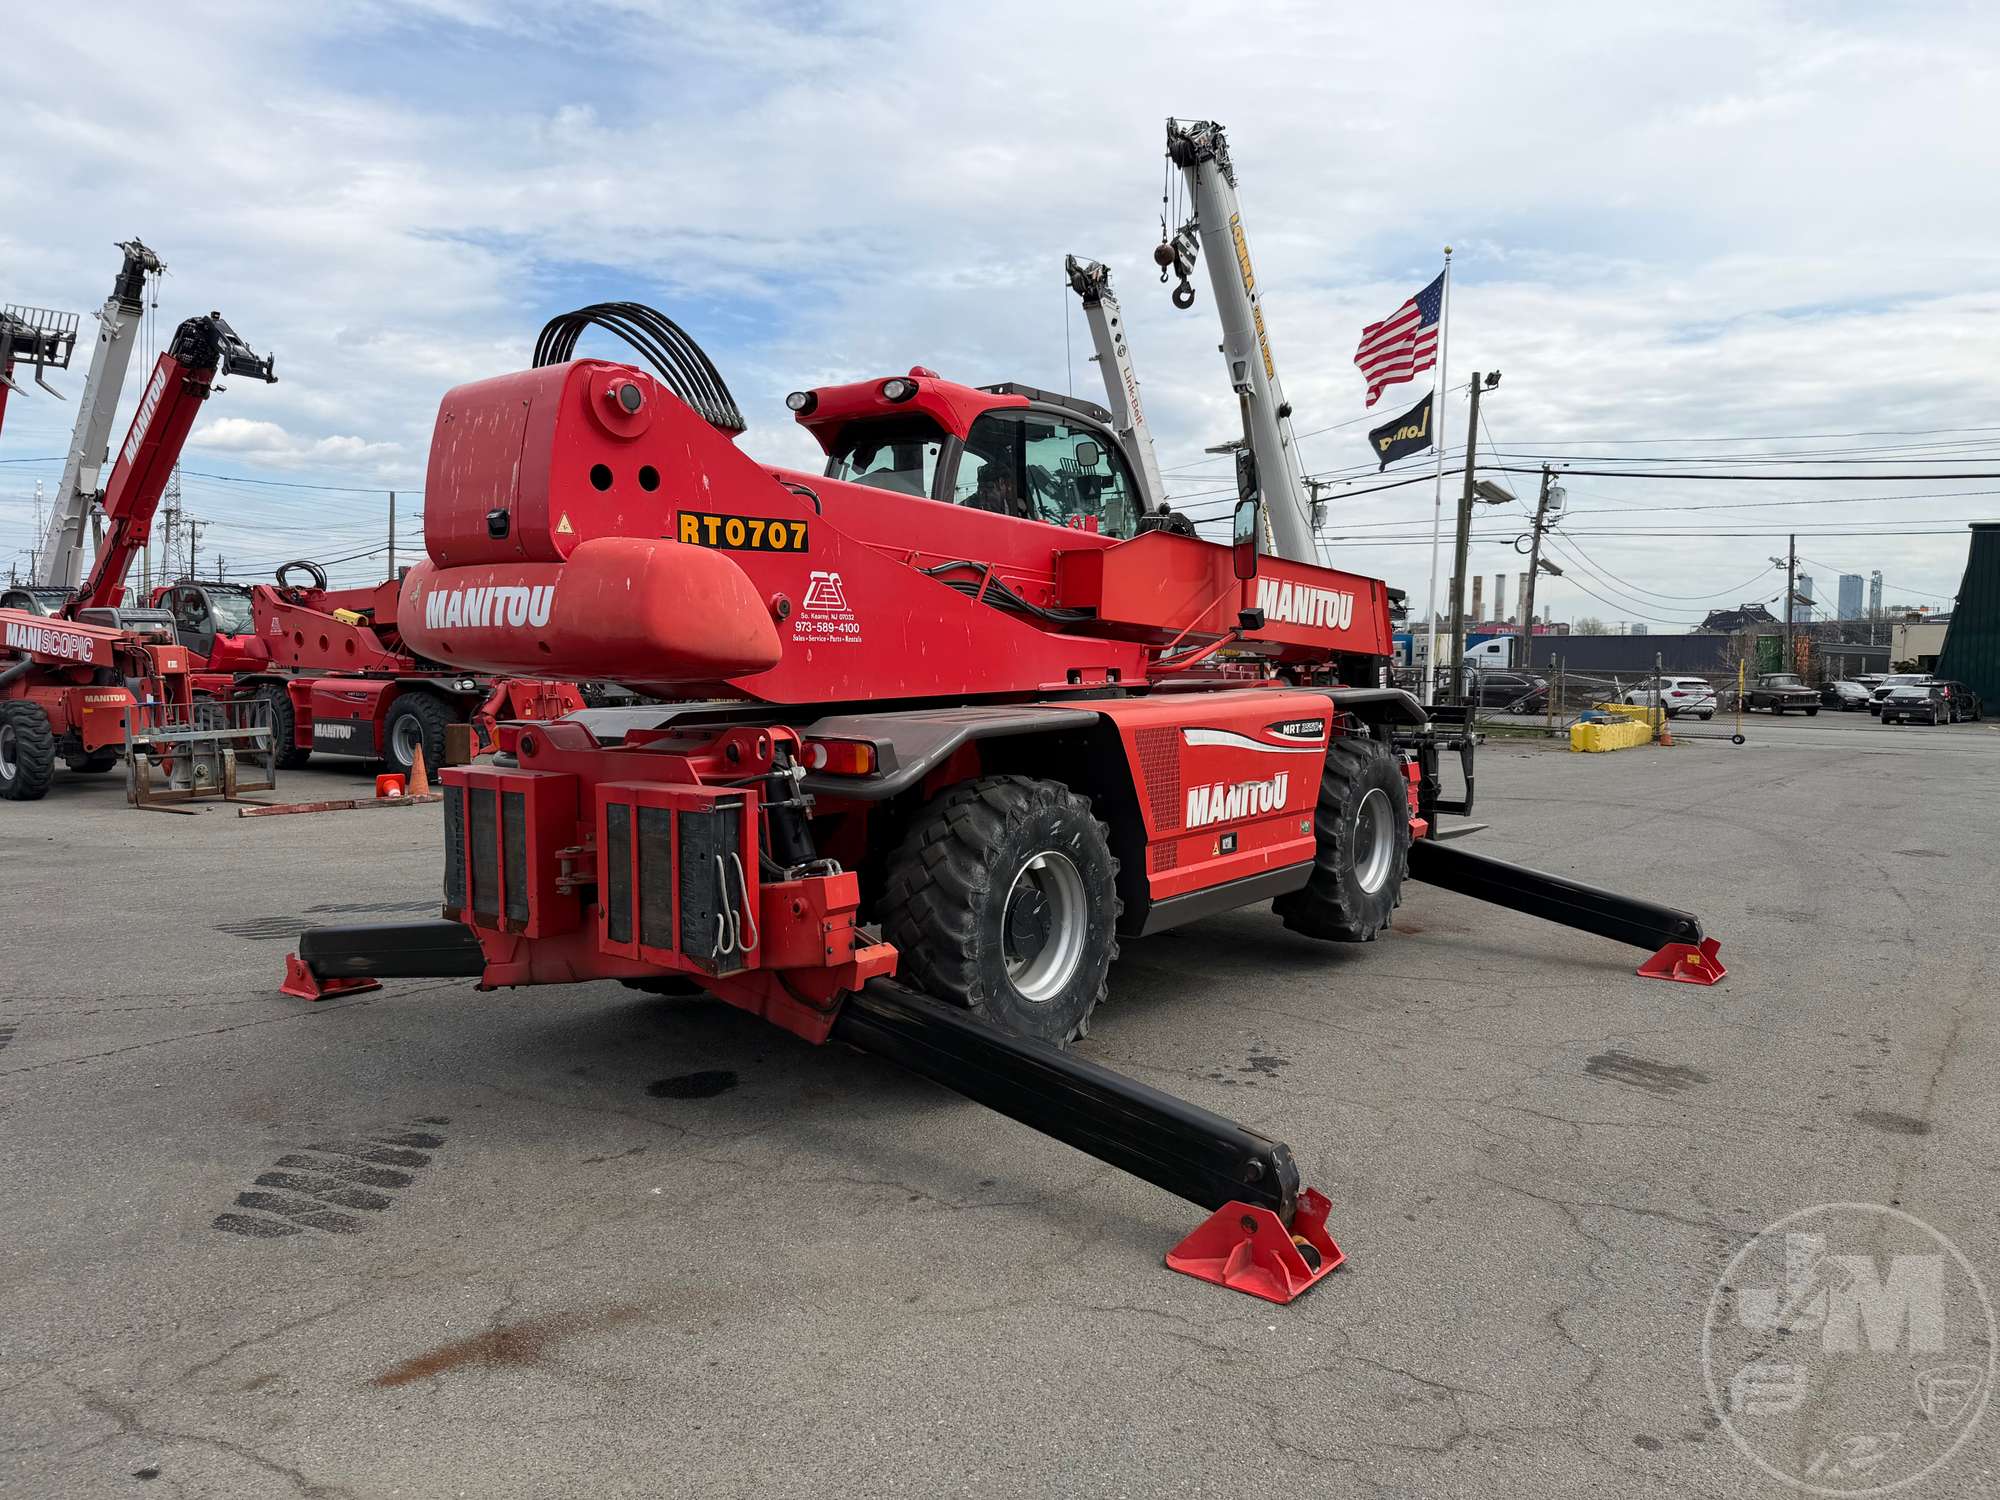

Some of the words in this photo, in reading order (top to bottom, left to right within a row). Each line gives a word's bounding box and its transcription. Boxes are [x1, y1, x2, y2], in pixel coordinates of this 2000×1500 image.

[124, 363, 166, 466] MANITOU
[679, 514, 807, 549] RT0707
[425, 585, 556, 630] MANITOU
[1256, 576, 1354, 630] MANITOU
[6, 622, 94, 662] MANISCOPIC
[795, 621, 860, 633] 973-589-4100
[85, 694, 126, 703] MANITOU
[314, 723, 352, 739] MANITOU
[1282, 723, 1301, 735] MRT
[1186, 771, 1289, 829] MANITOU
